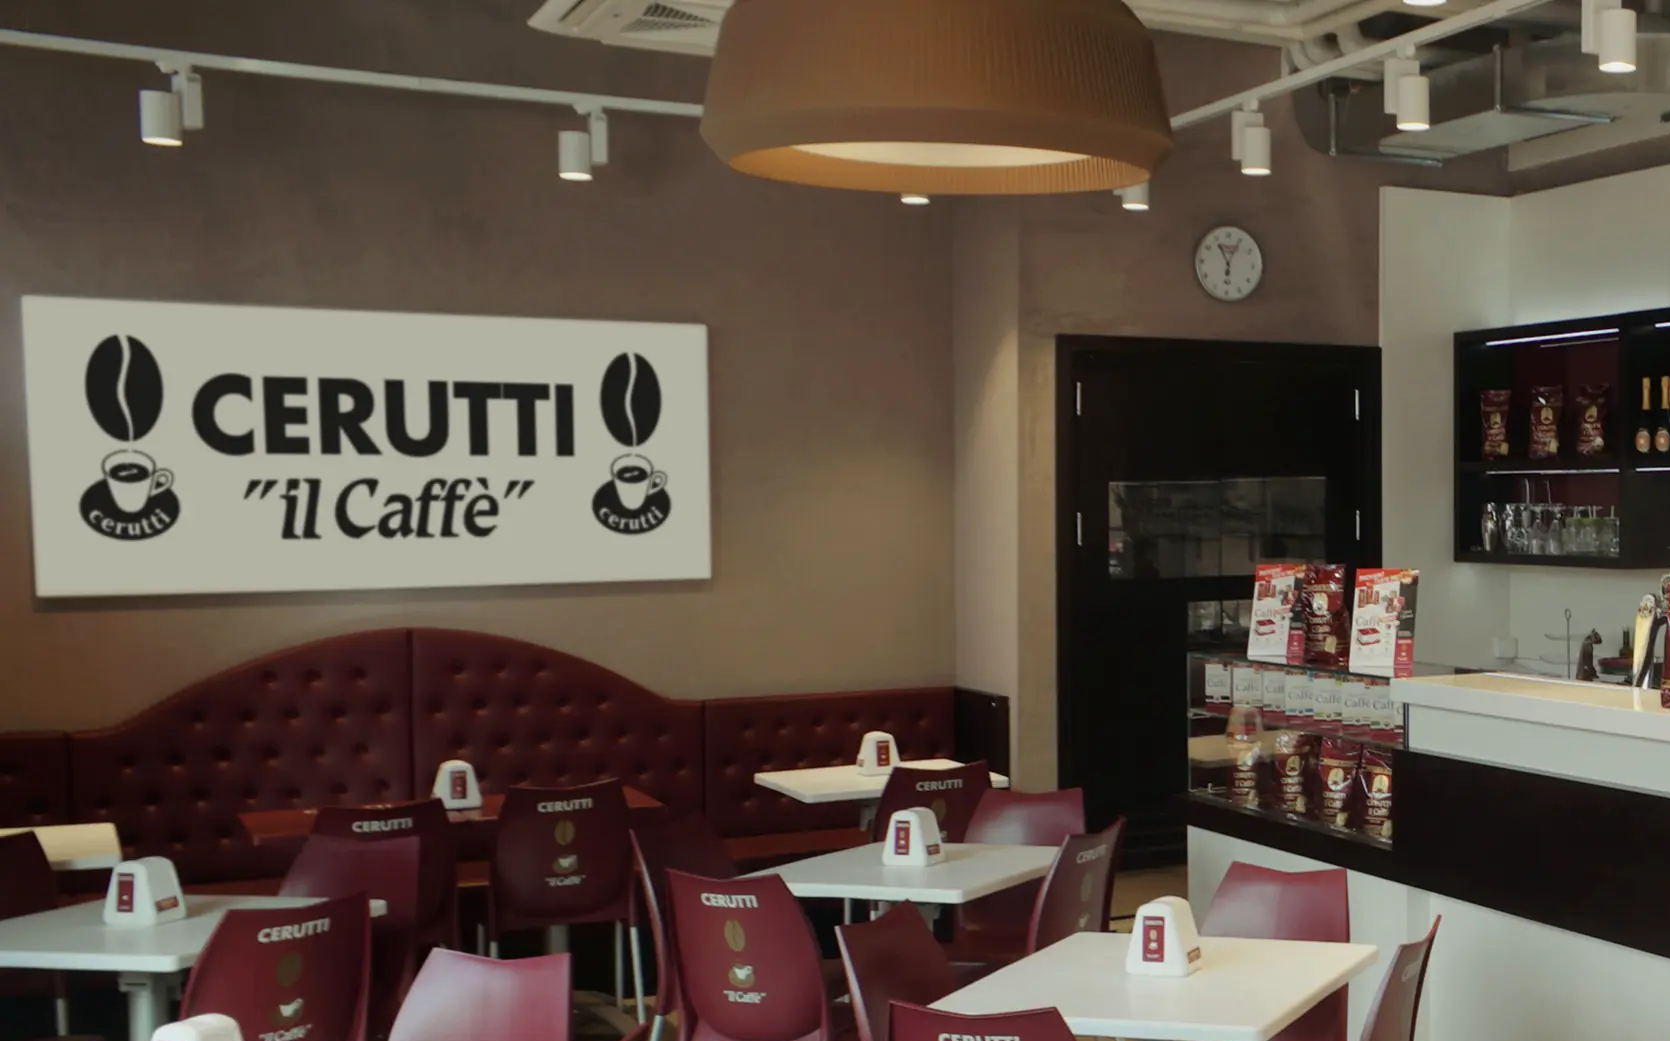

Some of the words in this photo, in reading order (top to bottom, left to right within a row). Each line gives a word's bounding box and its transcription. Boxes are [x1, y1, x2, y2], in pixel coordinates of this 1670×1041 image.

[192, 372, 576, 458] CERUTTI
[243, 478, 322, 539] "il
[334, 478, 535, 539] Caffè"
[599, 505, 664, 532] cerutti
[88, 507, 172, 537] cerutti
[916, 779, 964, 792] CERUTTI
[537, 797, 594, 813] CERUTTI
[352, 817, 413, 832] CERUTTI
[700, 892, 758, 909] CERUTTI
[256, 918, 331, 944] CERUTTI
